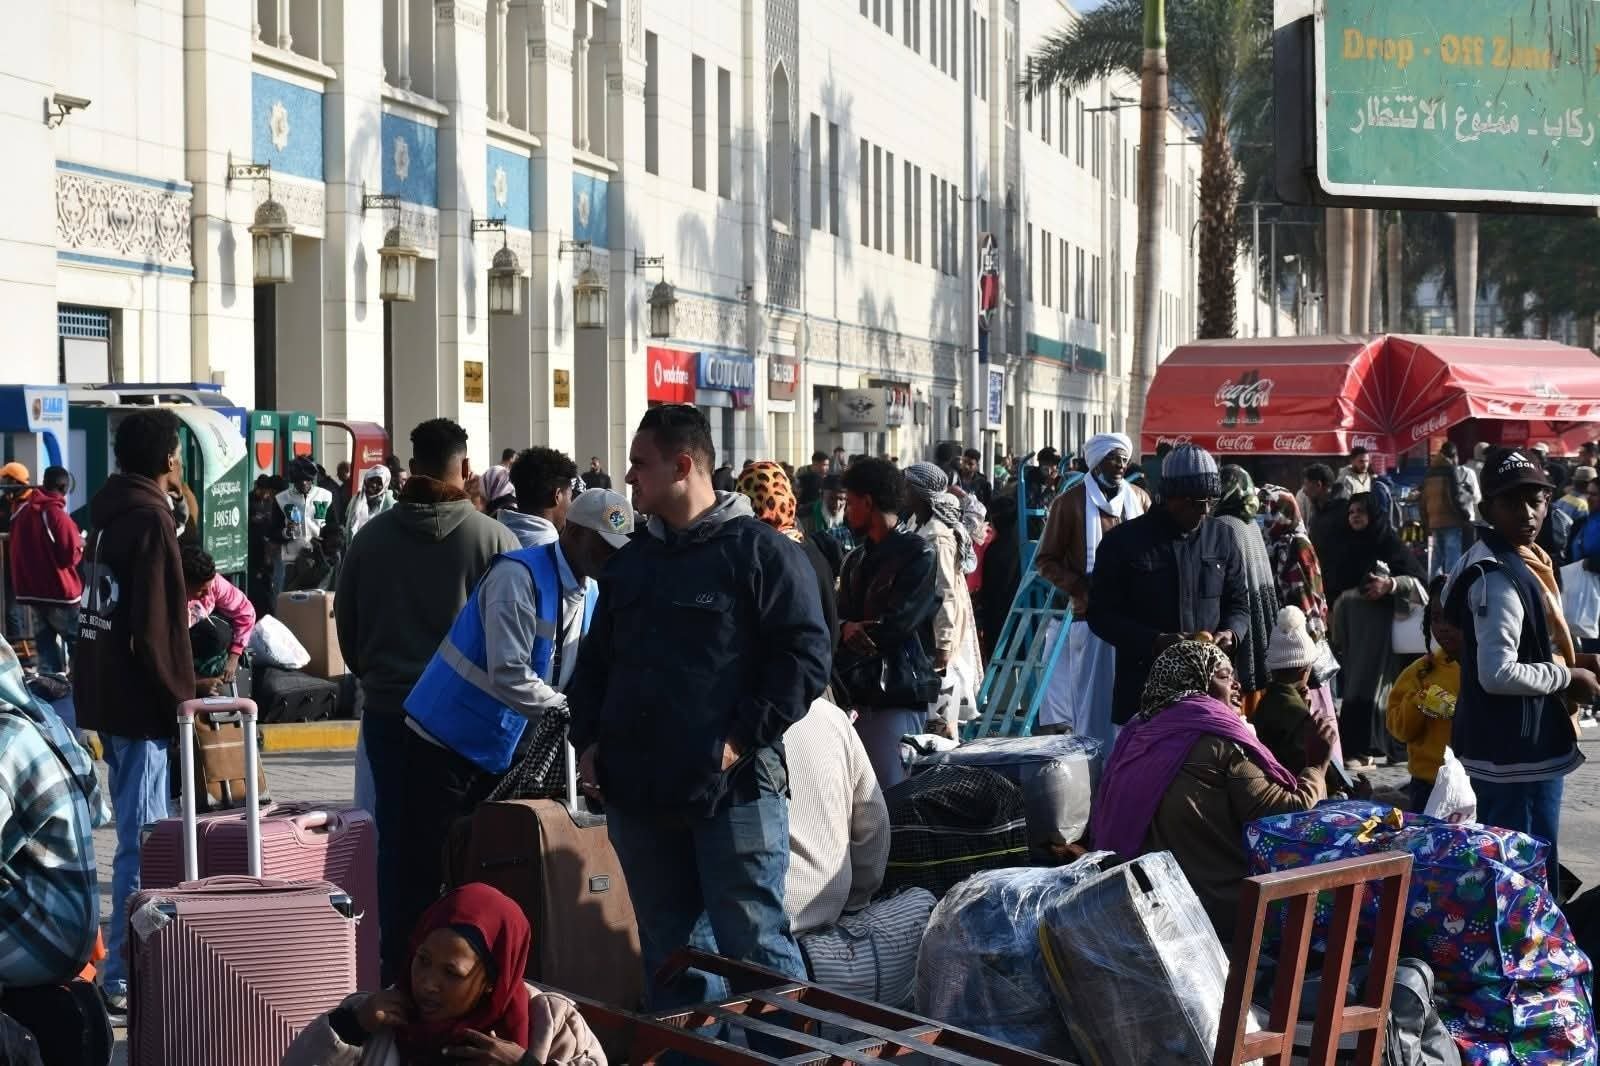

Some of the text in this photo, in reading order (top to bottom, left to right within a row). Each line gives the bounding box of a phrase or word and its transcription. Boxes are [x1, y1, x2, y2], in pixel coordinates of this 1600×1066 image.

[1343, 28, 1413, 69] Drop
[1440, 34, 1484, 65] Off
[1350, 94, 1447, 134] الانتظار
[1455, 100, 1519, 142] ممنوع
[663, 365, 689, 384] vodafone
[260, 414, 272, 426] ATM
[297, 415, 309, 427] ATM
[213, 510, 232, 527] 19851
